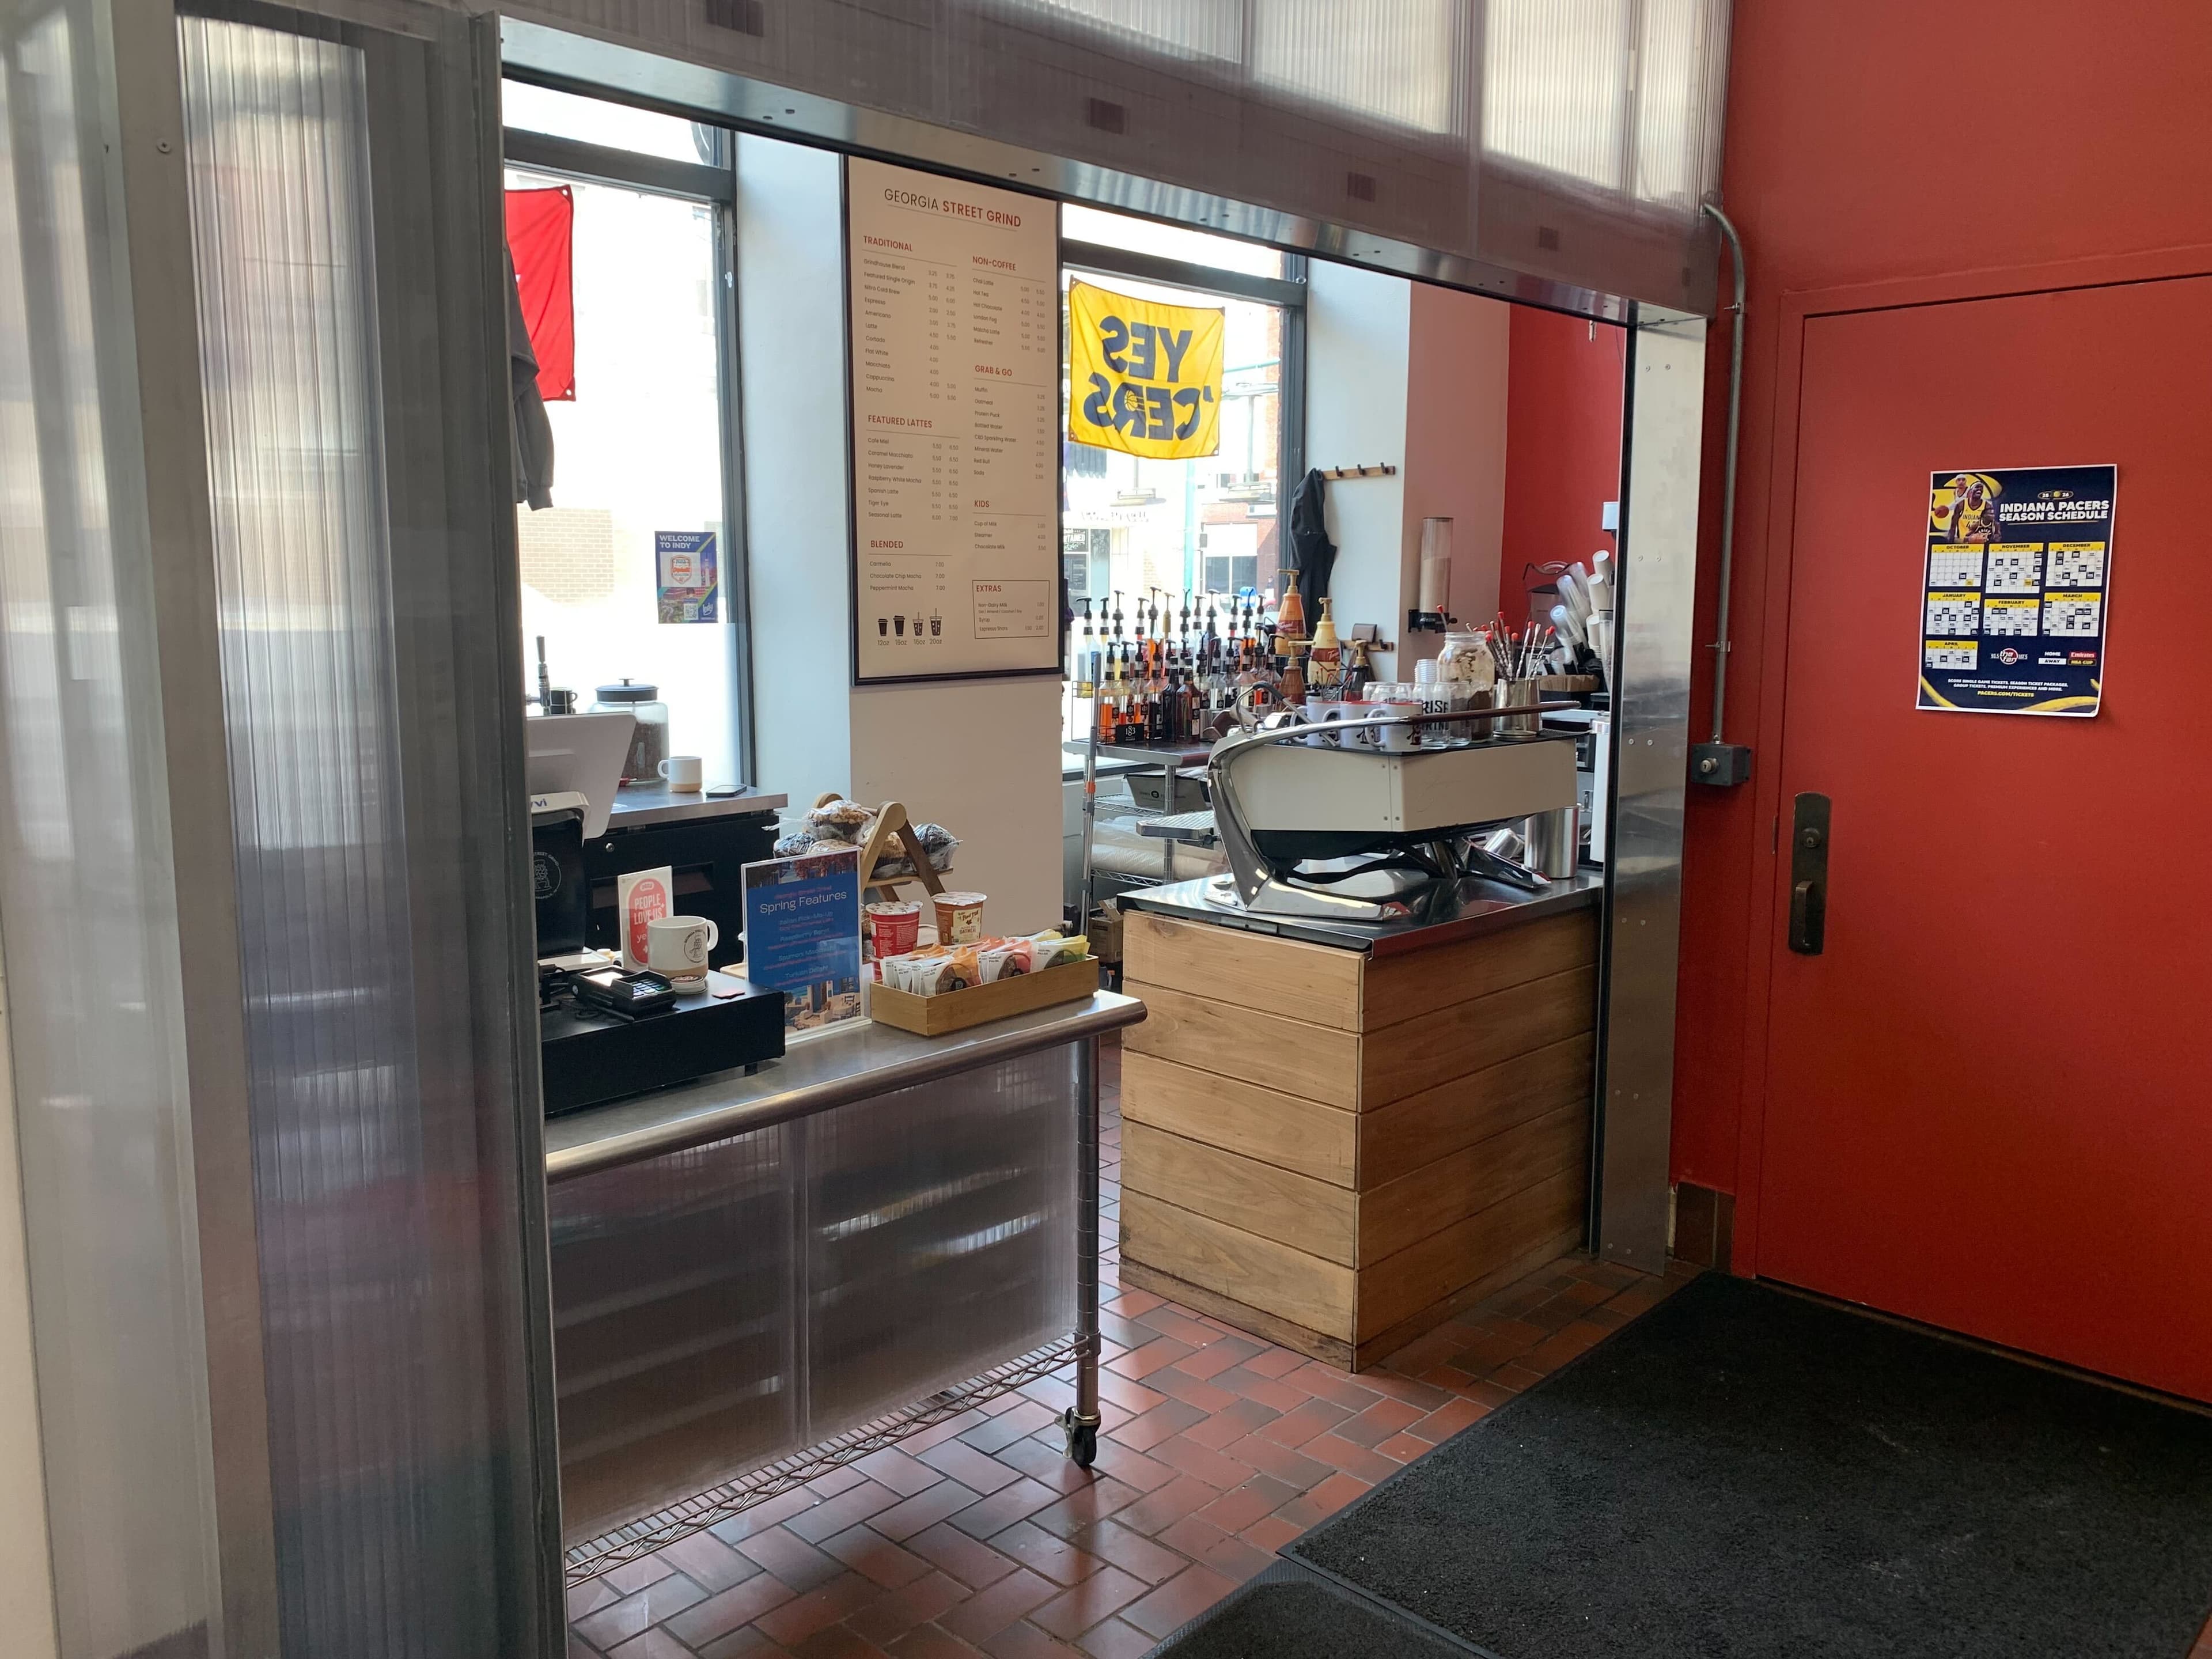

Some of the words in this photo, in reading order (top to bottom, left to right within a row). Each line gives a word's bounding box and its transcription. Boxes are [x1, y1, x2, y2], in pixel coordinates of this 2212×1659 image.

[885, 189, 938, 210] GEORGIA
[943, 200, 983, 219] STREET
[987, 210, 1021, 226] GRIND
[863, 236, 912, 252] TRADITIONAL
[972, 256, 1016, 272] NON-COFFEE
[865, 297, 885, 305] Espresso
[865, 310, 891, 318] Americano
[866, 361, 891, 369] Macchiato
[975, 365, 994, 374] GRAB
[868, 415, 905, 425] FEATURED
[907, 419, 931, 428] LATTES
[869, 475, 891, 483] Raspberry
[1999, 502, 2054, 513] INDIANA
[2058, 500, 2109, 510] PACERS
[1999, 512, 2044, 522] SEASON
[2047, 510, 2108, 520] SCHEDULE
[635, 893, 661, 910] PEOPLE
[760, 900, 796, 915] Spring
[798, 891, 847, 907] Features
[634, 910, 651, 925] LOVE
[653, 907, 662, 920] US
